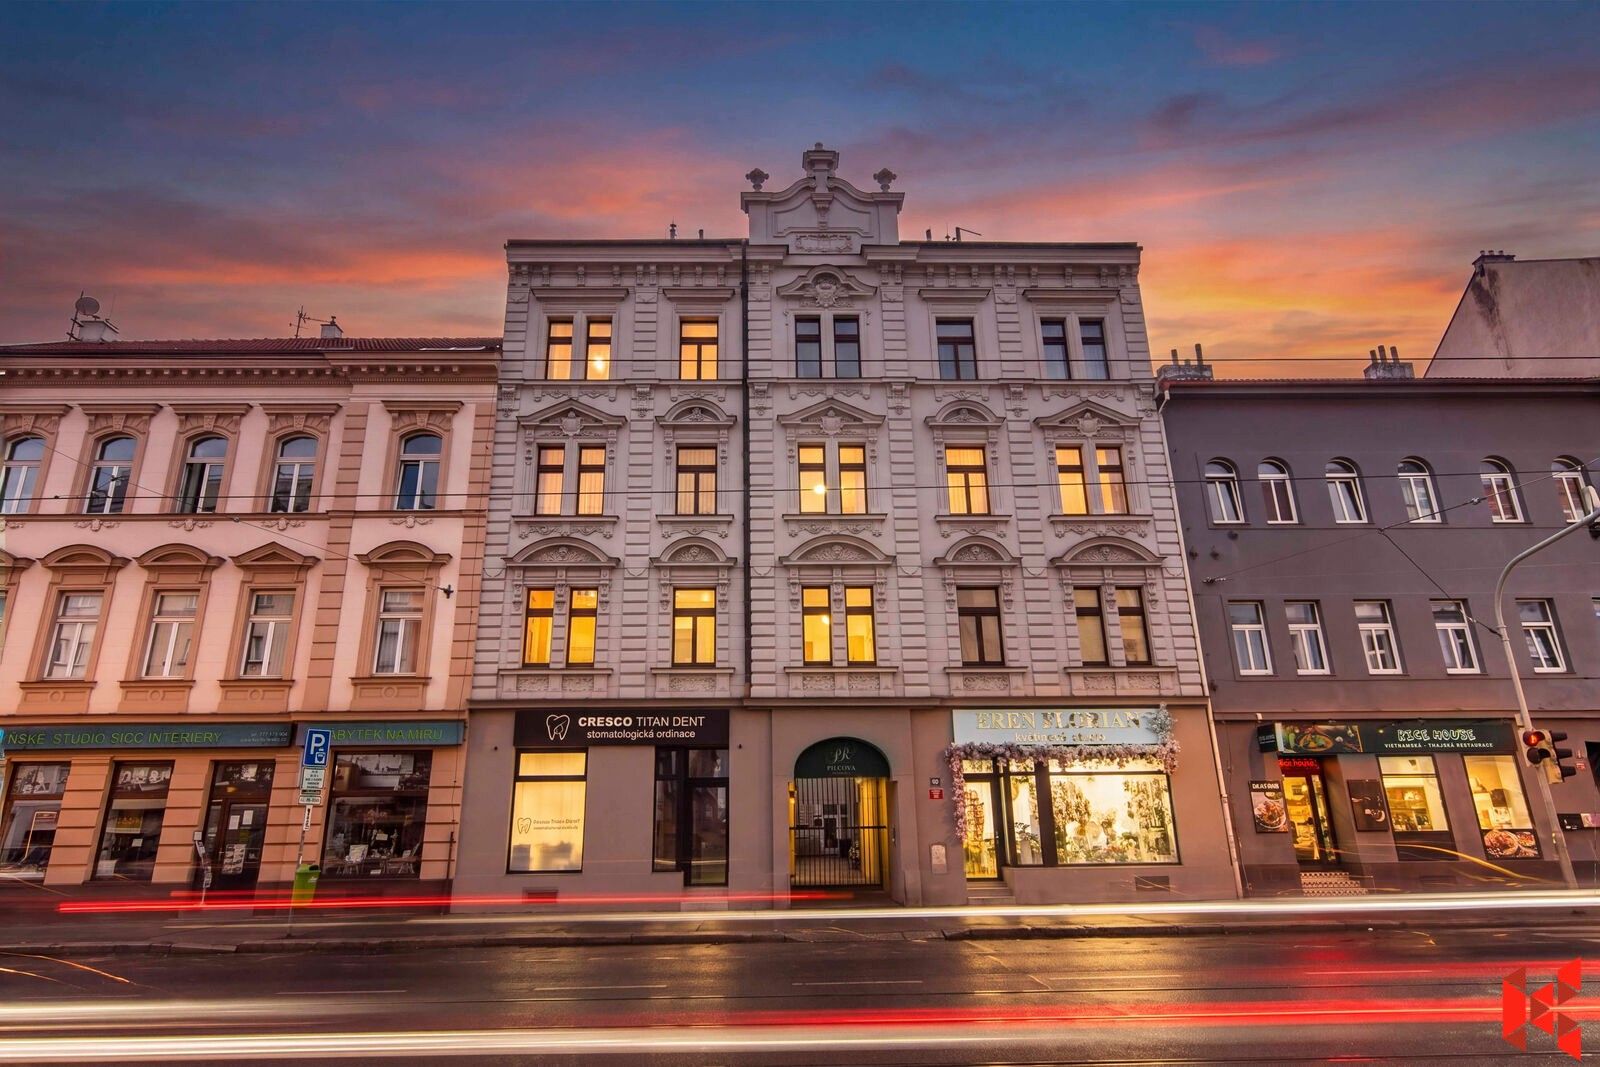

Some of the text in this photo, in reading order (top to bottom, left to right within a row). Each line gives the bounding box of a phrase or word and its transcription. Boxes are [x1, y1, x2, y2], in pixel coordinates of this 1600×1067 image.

[578, 716, 705, 727] CRESCO TITAN DENT
[976, 711, 1142, 729] EREN FLORIAN
[52, 732, 106, 744] STUDIO
[111, 732, 144, 744] SICC
[148, 732, 222, 743] INTERIERY
[386, 729, 405, 740] NA
[586, 729, 696, 740] stomatologická ordinace
[1397, 728, 1476, 741] RICE HOUSE
[310, 733, 326, 755] P
